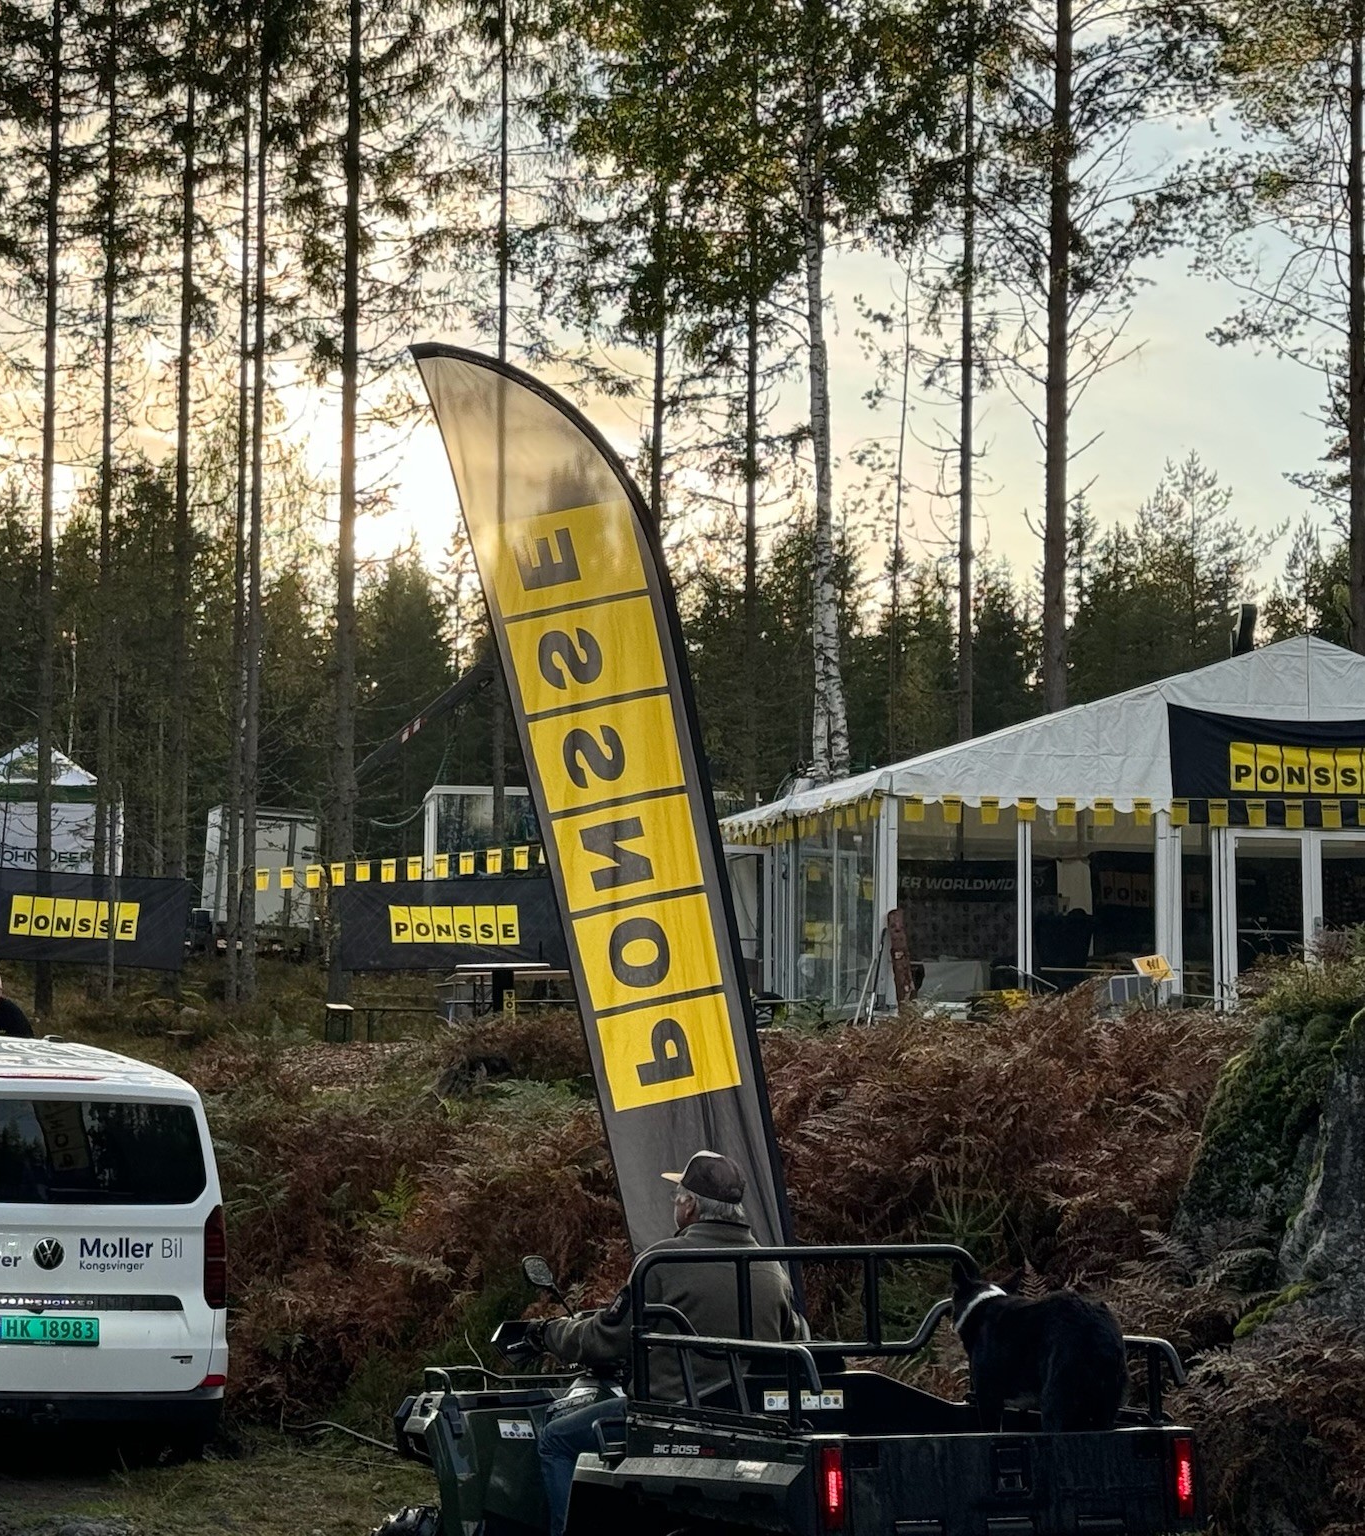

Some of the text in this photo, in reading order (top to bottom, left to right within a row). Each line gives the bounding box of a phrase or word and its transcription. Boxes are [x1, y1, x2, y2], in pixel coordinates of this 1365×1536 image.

[1235, 764, 1358, 787] PONSS
[50, 849, 94, 863] DEER
[925, 878, 1018, 891] WORLDWID
[1103, 886, 1200, 903] PONE
[13, 913, 134, 934] PONSSE
[395, 921, 516, 939] PONSSE
[161, 1237, 183, 1259] Bil
[79, 1260, 145, 1273] Kongsvinger
[6, 1319, 94, 1340] HK 18983
[652, 1443, 670, 1454] BIG
[671, 1444, 702, 1455] BOSS
